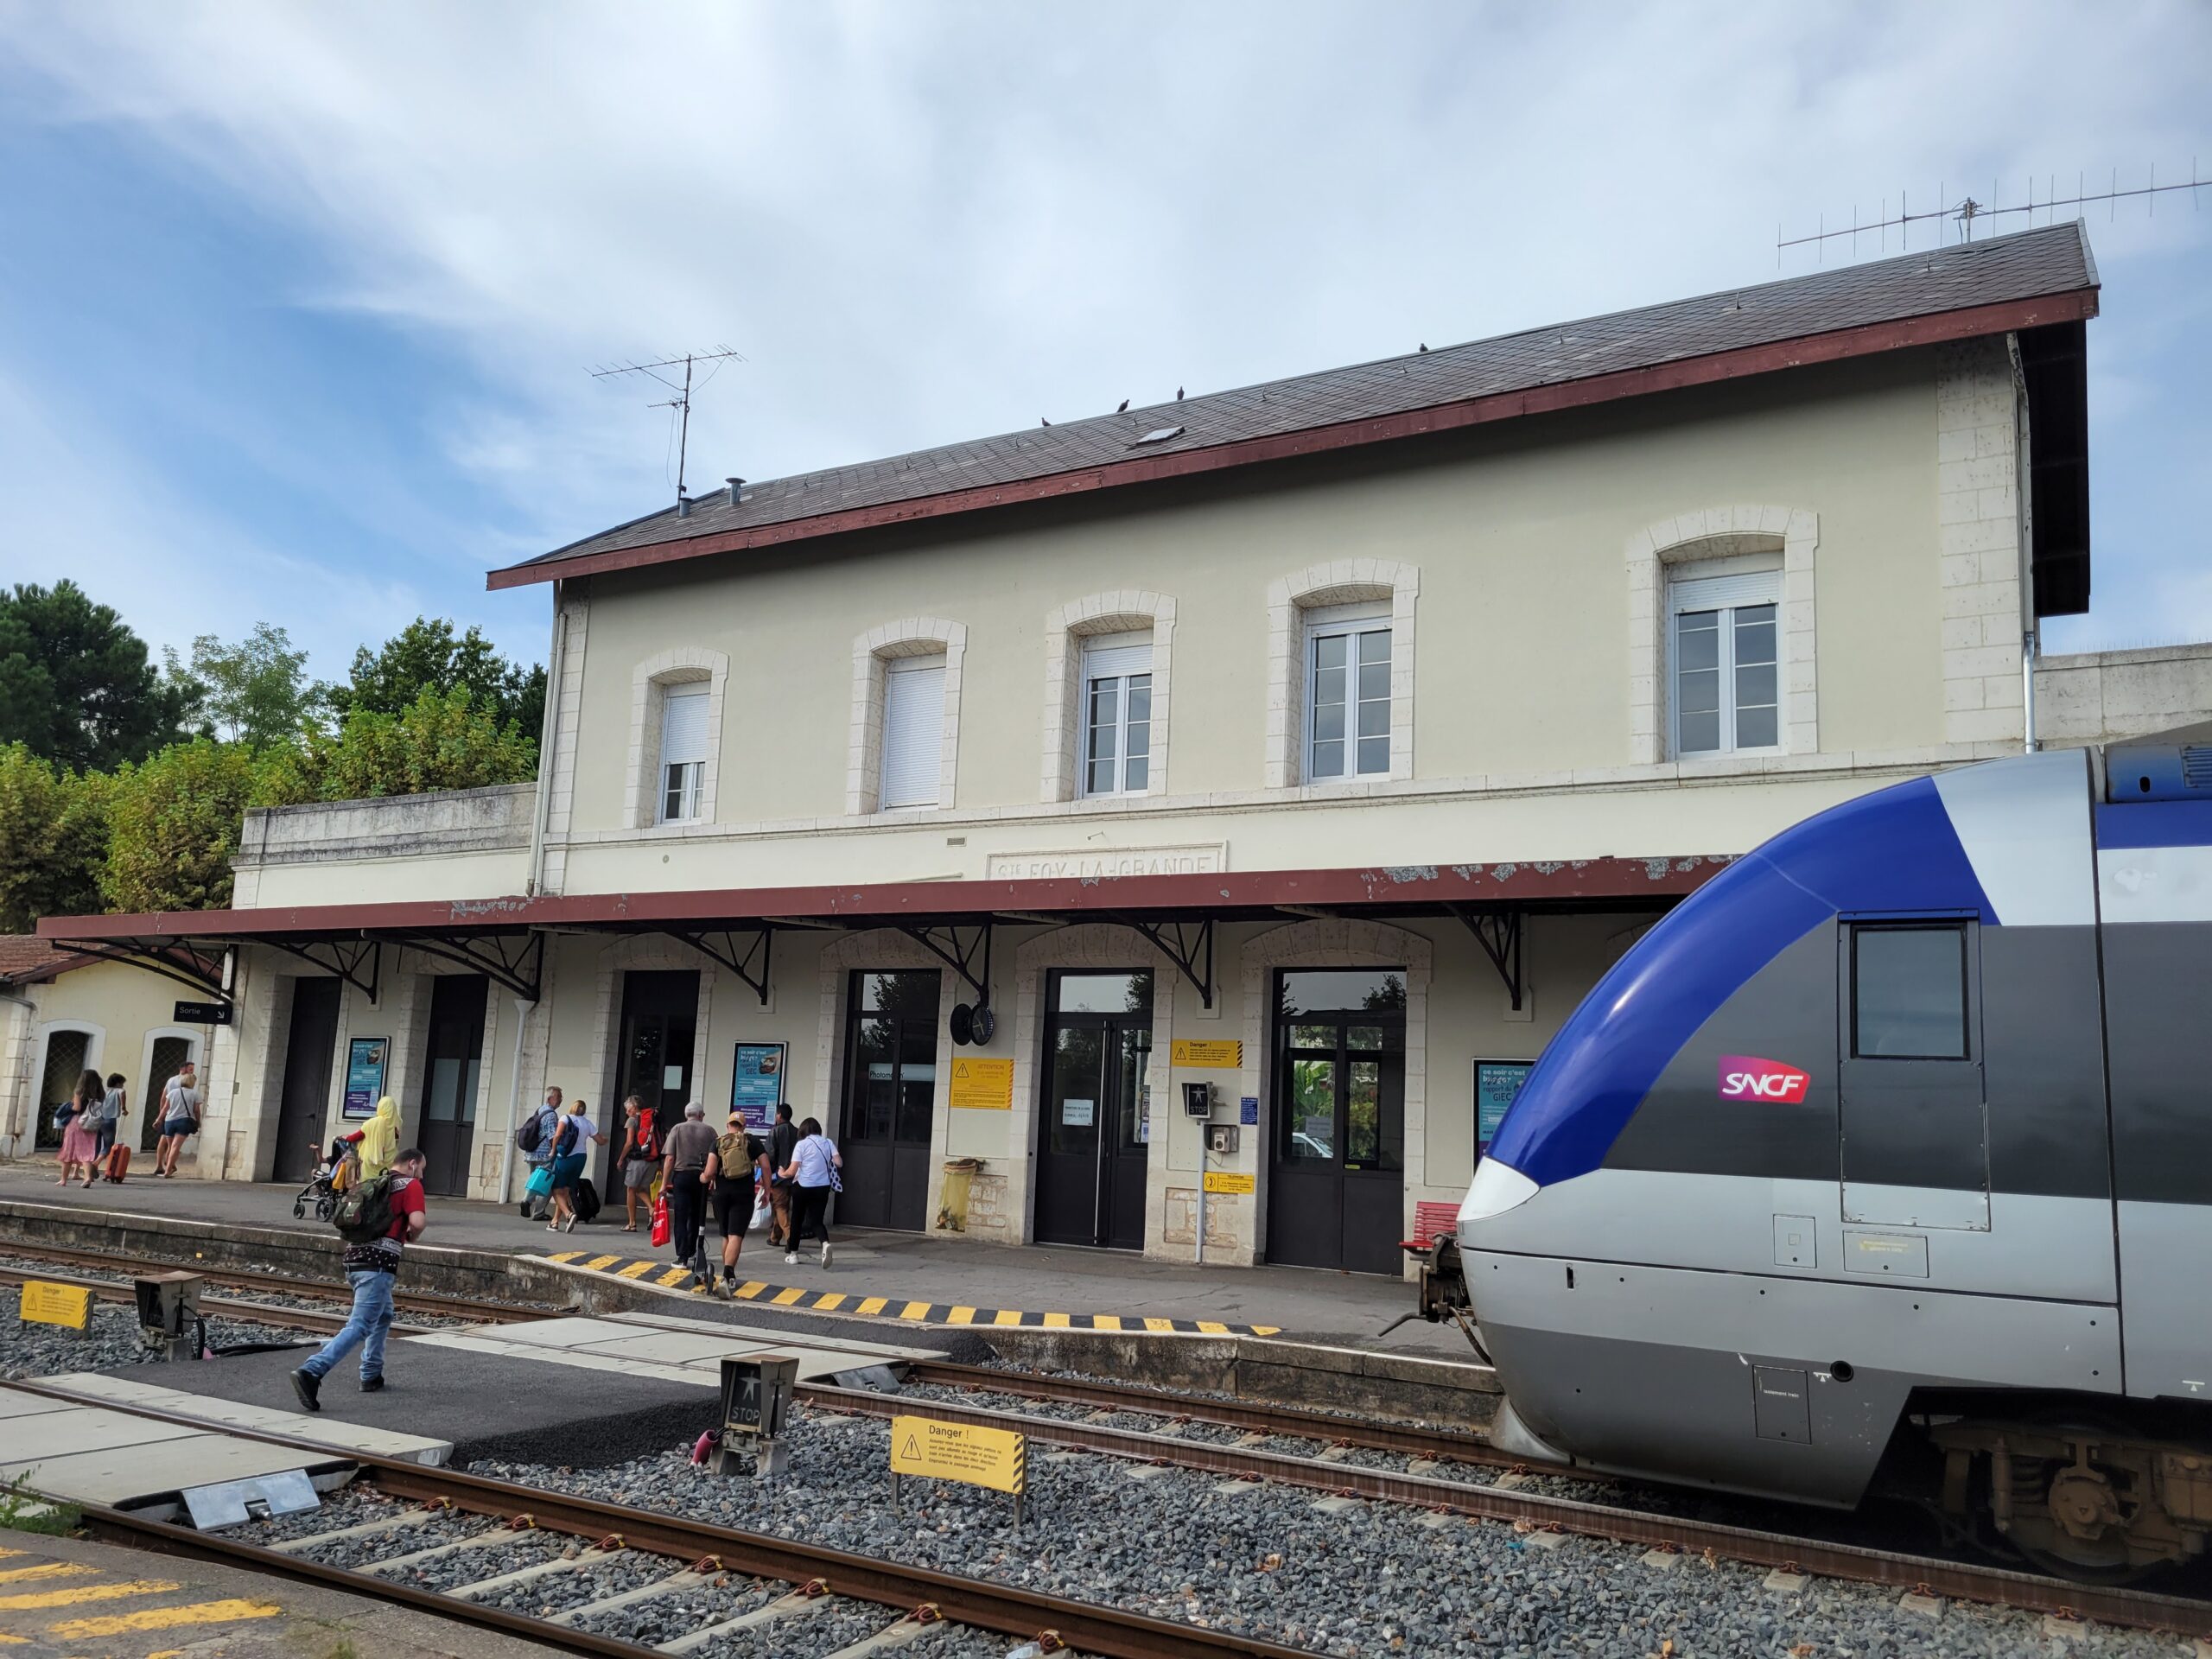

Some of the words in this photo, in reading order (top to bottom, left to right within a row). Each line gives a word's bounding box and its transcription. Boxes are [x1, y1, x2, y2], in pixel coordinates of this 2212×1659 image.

[179, 1006, 201, 1014] Sortie
[1722, 1073, 1803, 1096] SNCF
[1493, 1092, 1512, 1102] GIEC
[42, 1286, 60, 1295] Danger
[733, 1407, 760, 1422] STOP
[929, 1424, 963, 1439] Danger
